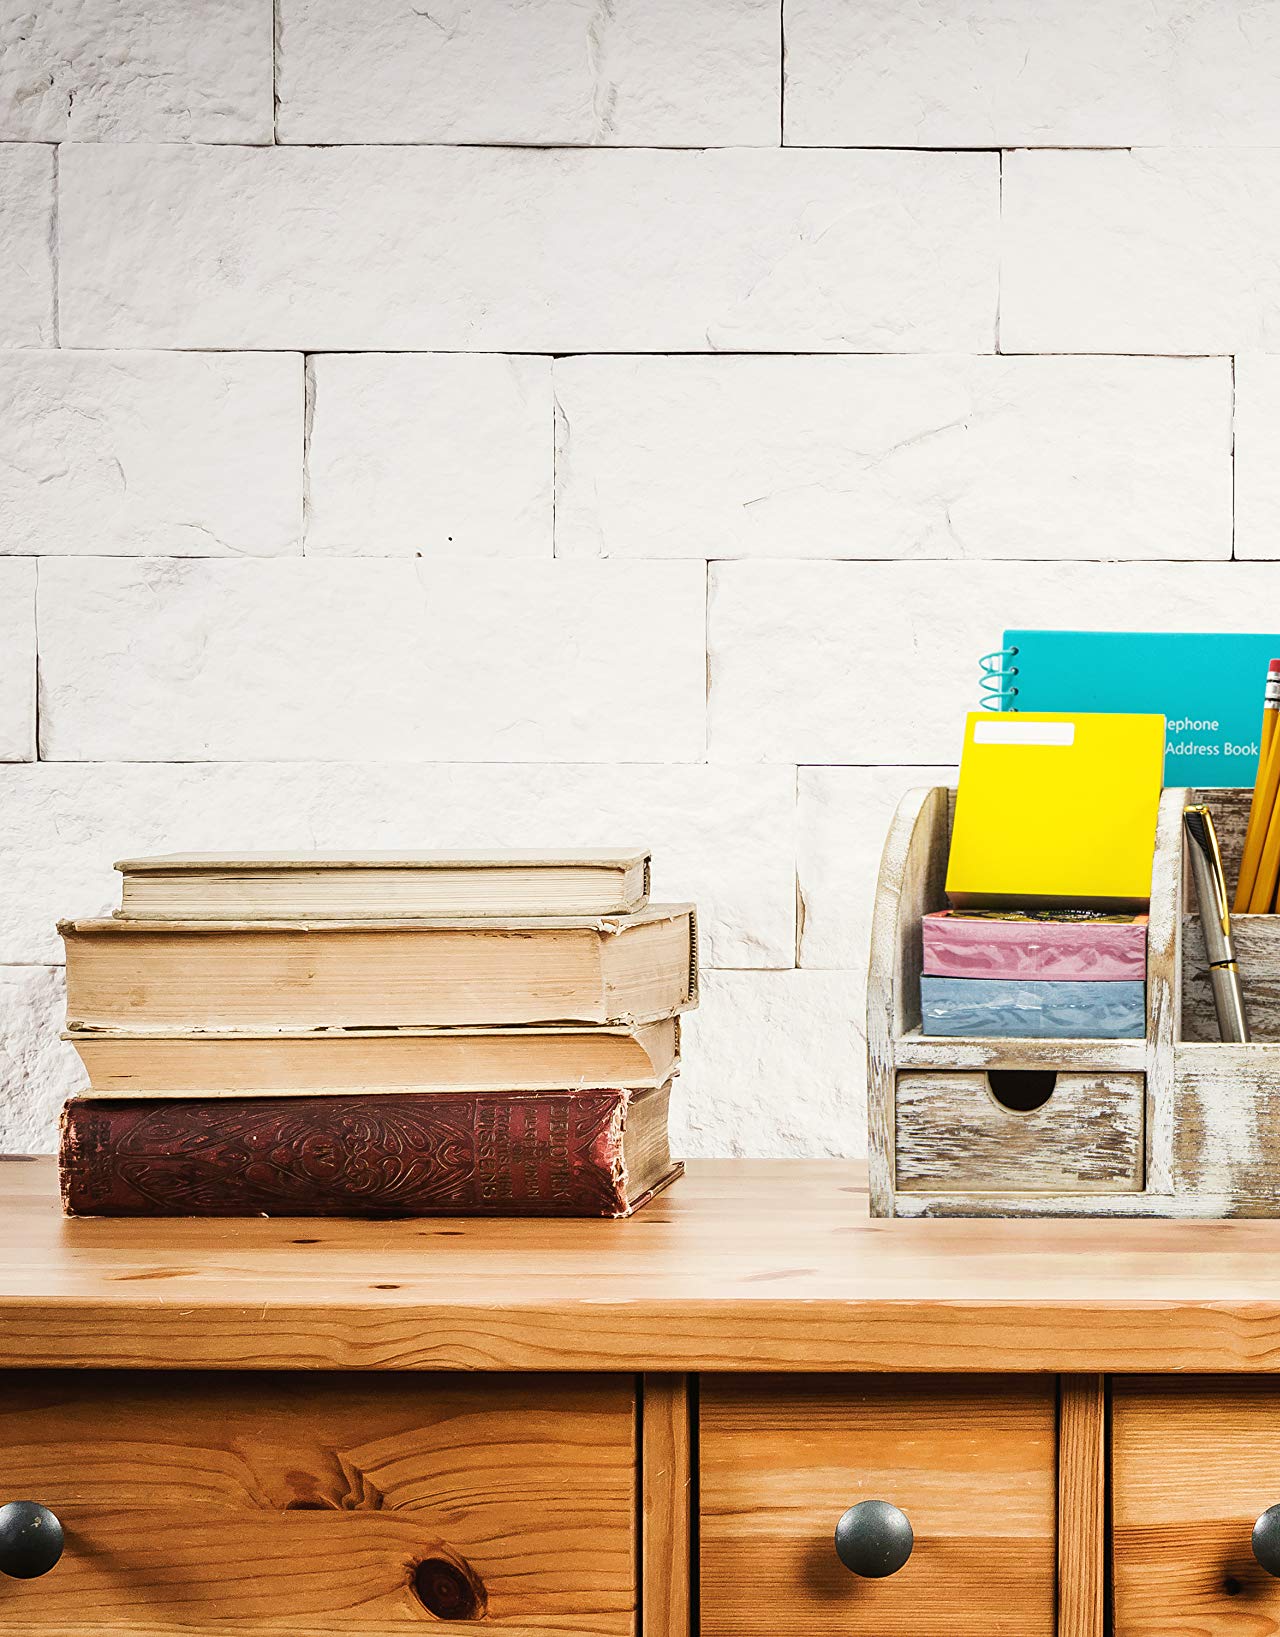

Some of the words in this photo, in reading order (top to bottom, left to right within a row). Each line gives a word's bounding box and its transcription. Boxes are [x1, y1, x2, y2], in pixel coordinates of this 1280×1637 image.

[1165, 742, 1220, 756] Address
[1224, 742, 1258, 756] Book
[479, 1107, 497, 1198] WISSENS
